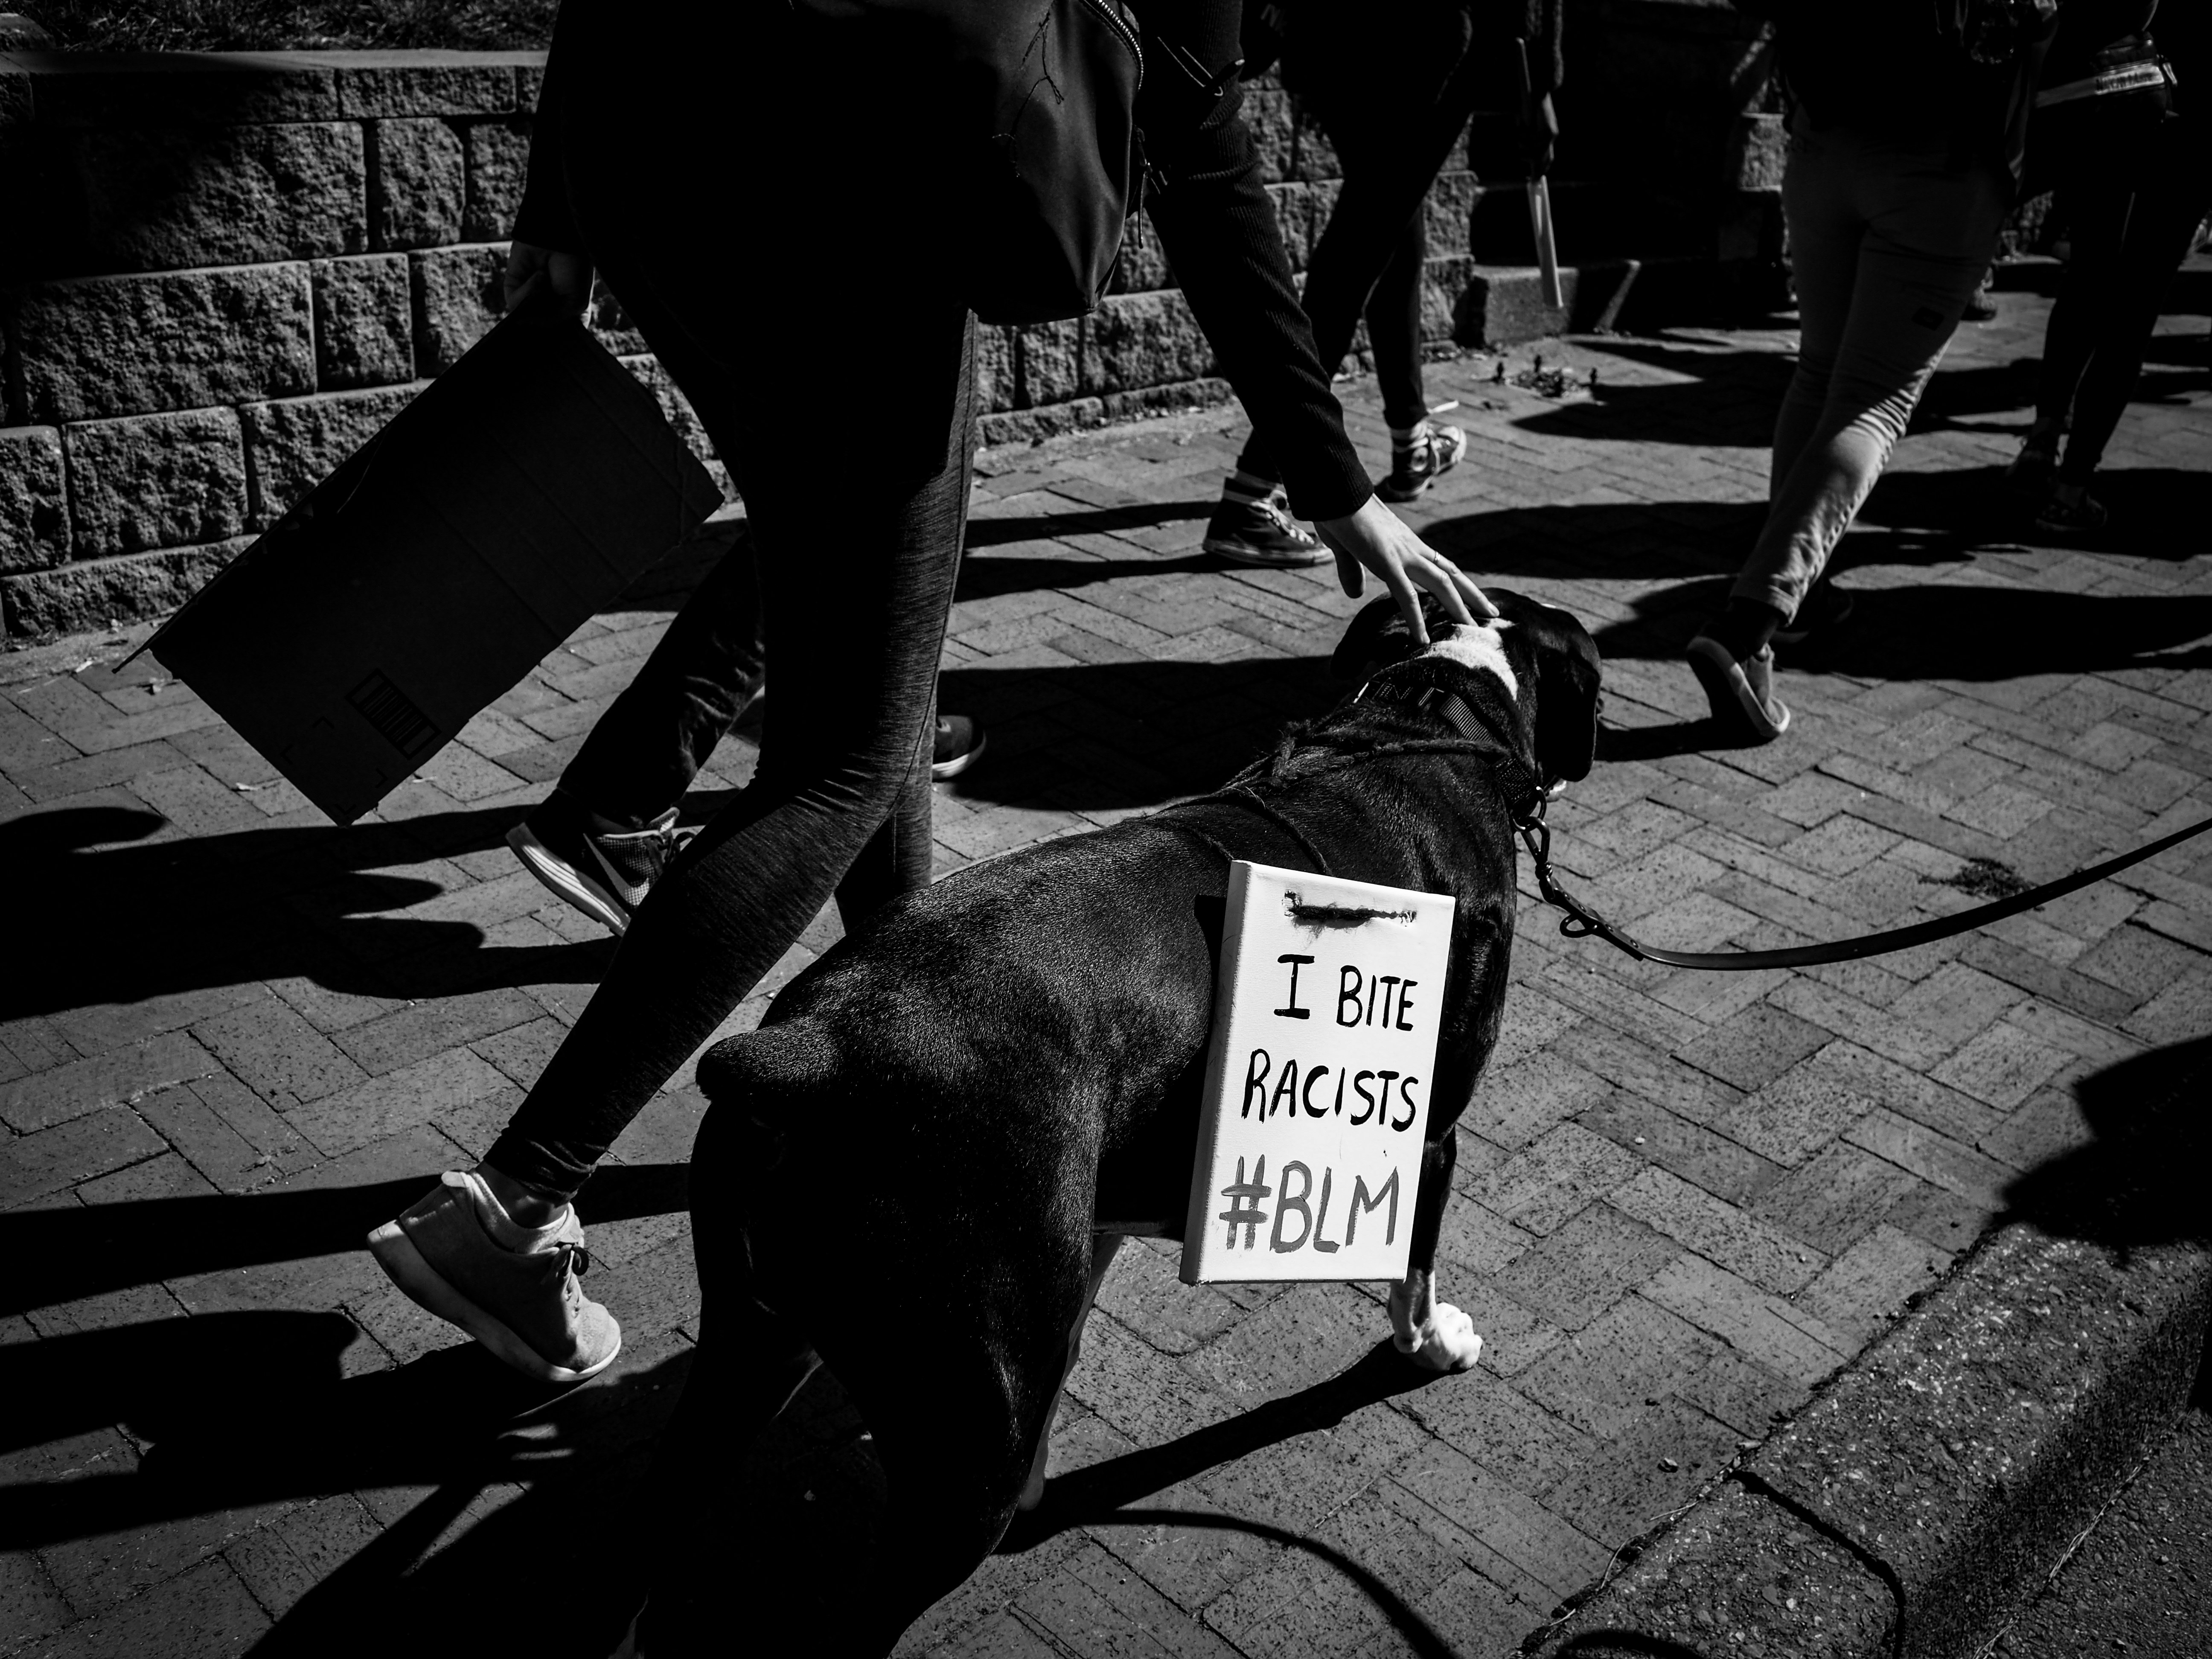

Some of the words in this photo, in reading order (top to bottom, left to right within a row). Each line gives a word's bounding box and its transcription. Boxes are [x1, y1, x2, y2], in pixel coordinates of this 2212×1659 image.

[1273, 954, 1315, 1020] I
[1336, 965, 1418, 1031] BITE
[1241, 1048, 1419, 1132] RACISTS
[1219, 1154, 1399, 1254] #BLM
